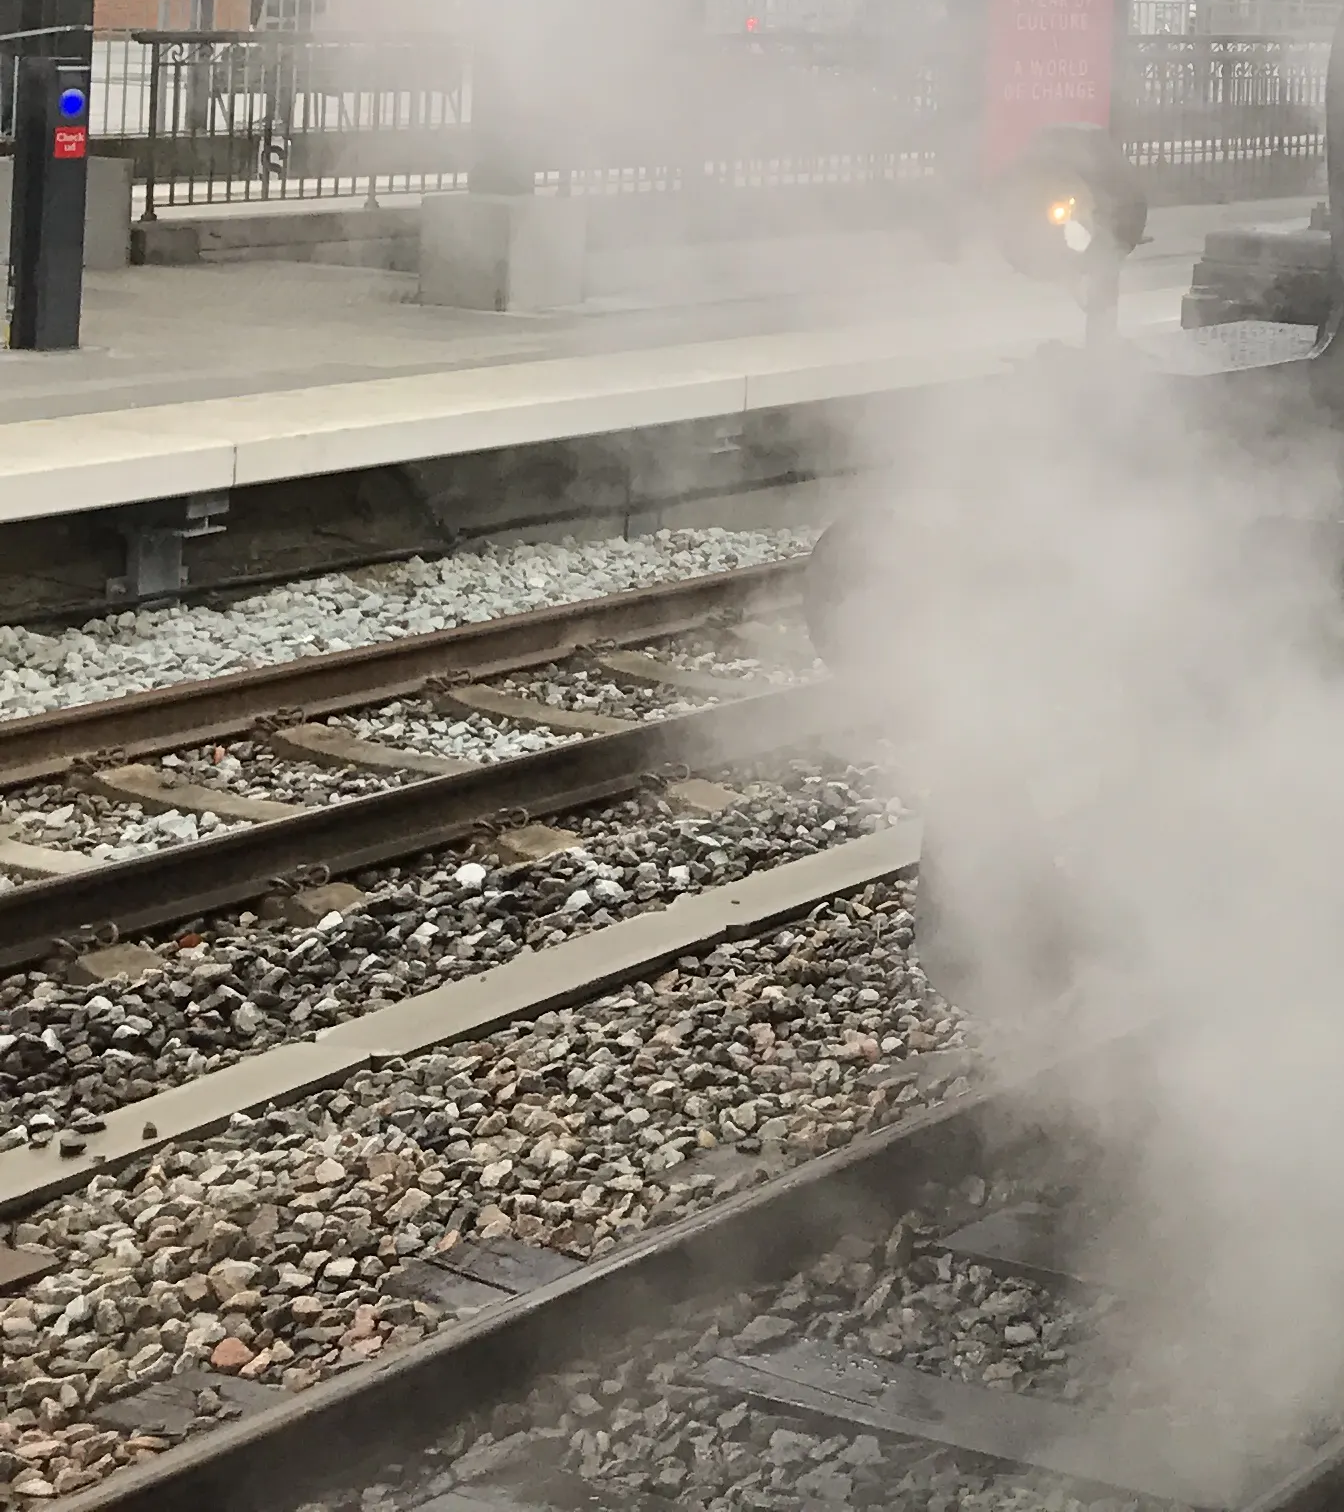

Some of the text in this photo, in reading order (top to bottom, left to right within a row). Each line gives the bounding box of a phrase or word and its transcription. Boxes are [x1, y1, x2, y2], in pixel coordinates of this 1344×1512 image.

[1016, 12, 1088, 32] CULTURE
[1013, 58, 1088, 77] A WORLD
[1004, 80, 1096, 101] OF CHANGE
[56, 132, 85, 143] Check
[64, 142, 76, 152] ud
